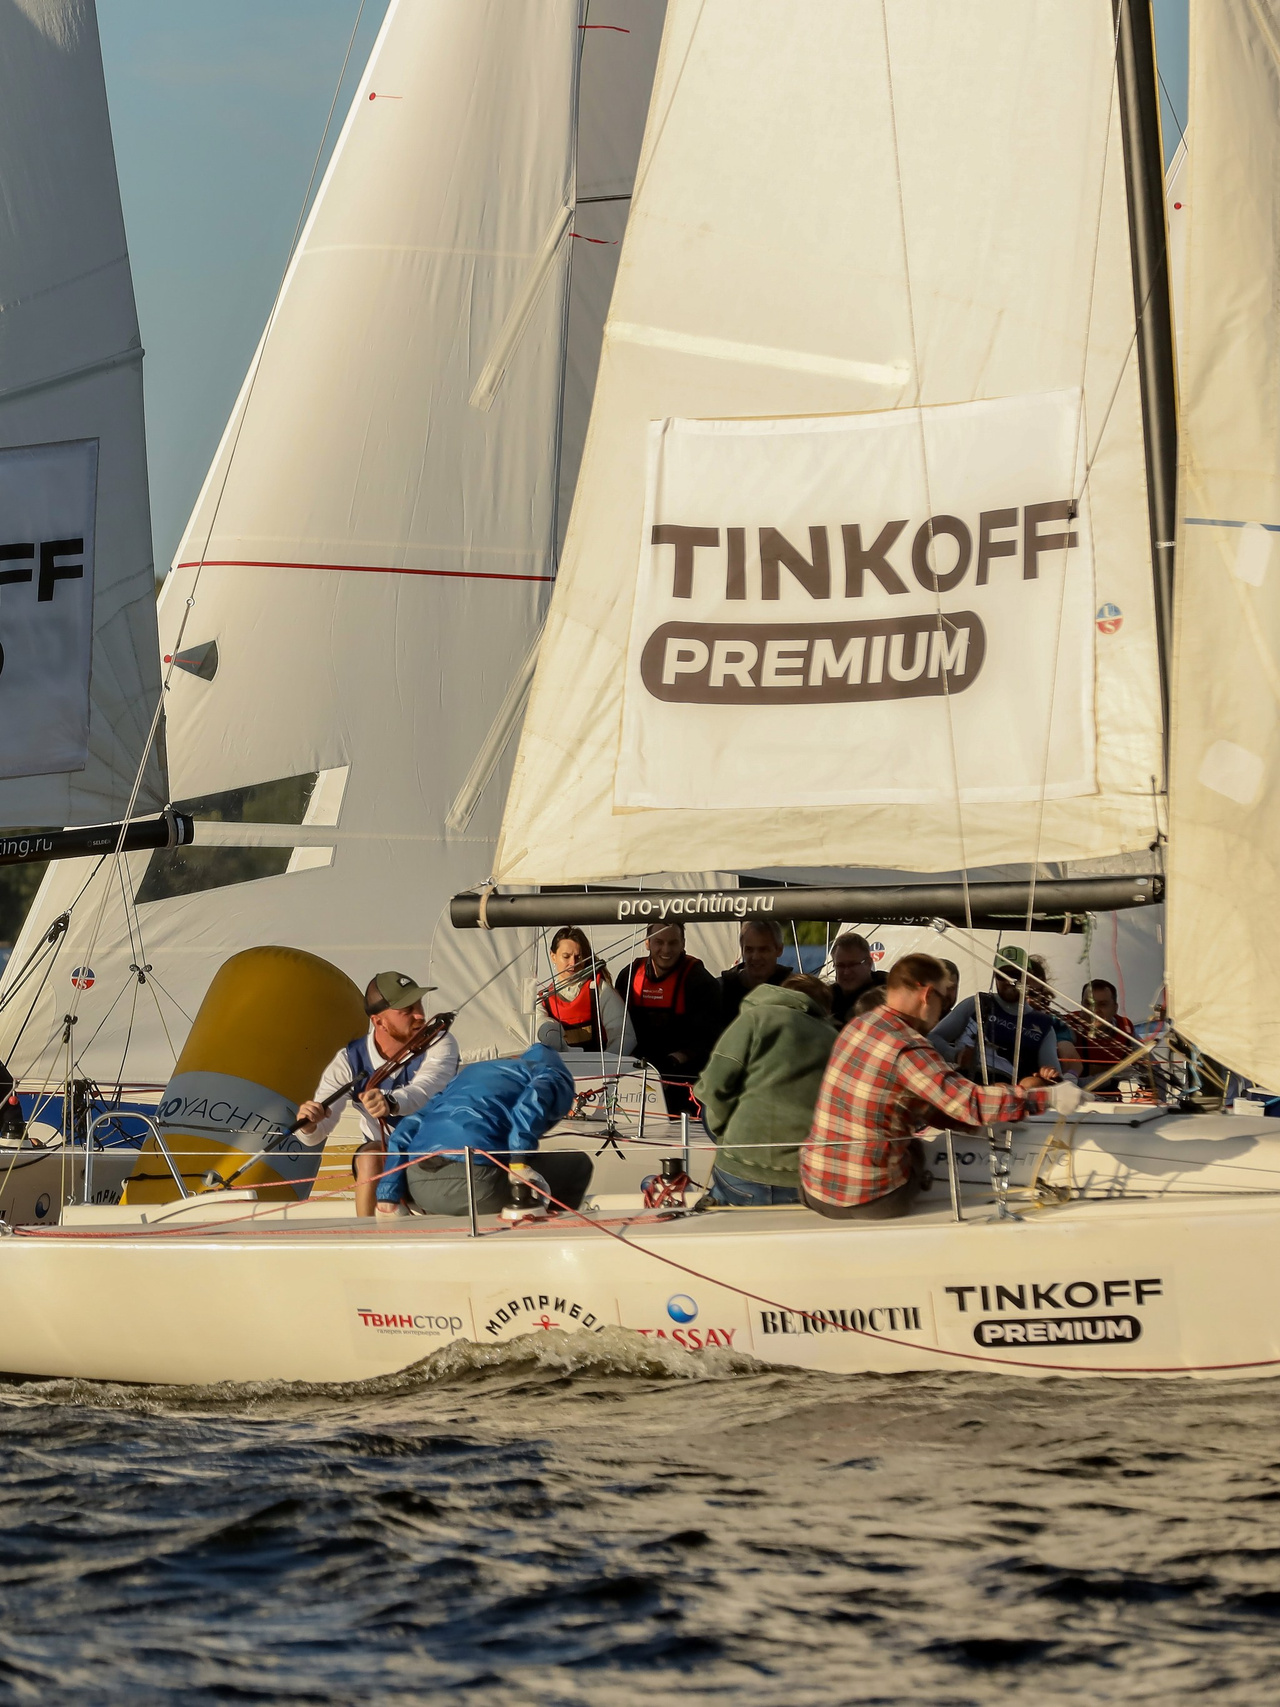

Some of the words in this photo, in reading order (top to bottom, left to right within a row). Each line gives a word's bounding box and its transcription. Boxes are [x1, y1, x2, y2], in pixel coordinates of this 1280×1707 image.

[652, 499, 1079, 600] TINKOFF
[661, 628, 970, 688] PREMIUM
[617, 892, 775, 921] pro-yachting.ru
[945, 1278, 1164, 1312] TINKOFF
[760, 1306, 923, 1336] ВЕДОМОСТИ
[982, 1319, 1134, 1343] PREMIUM
